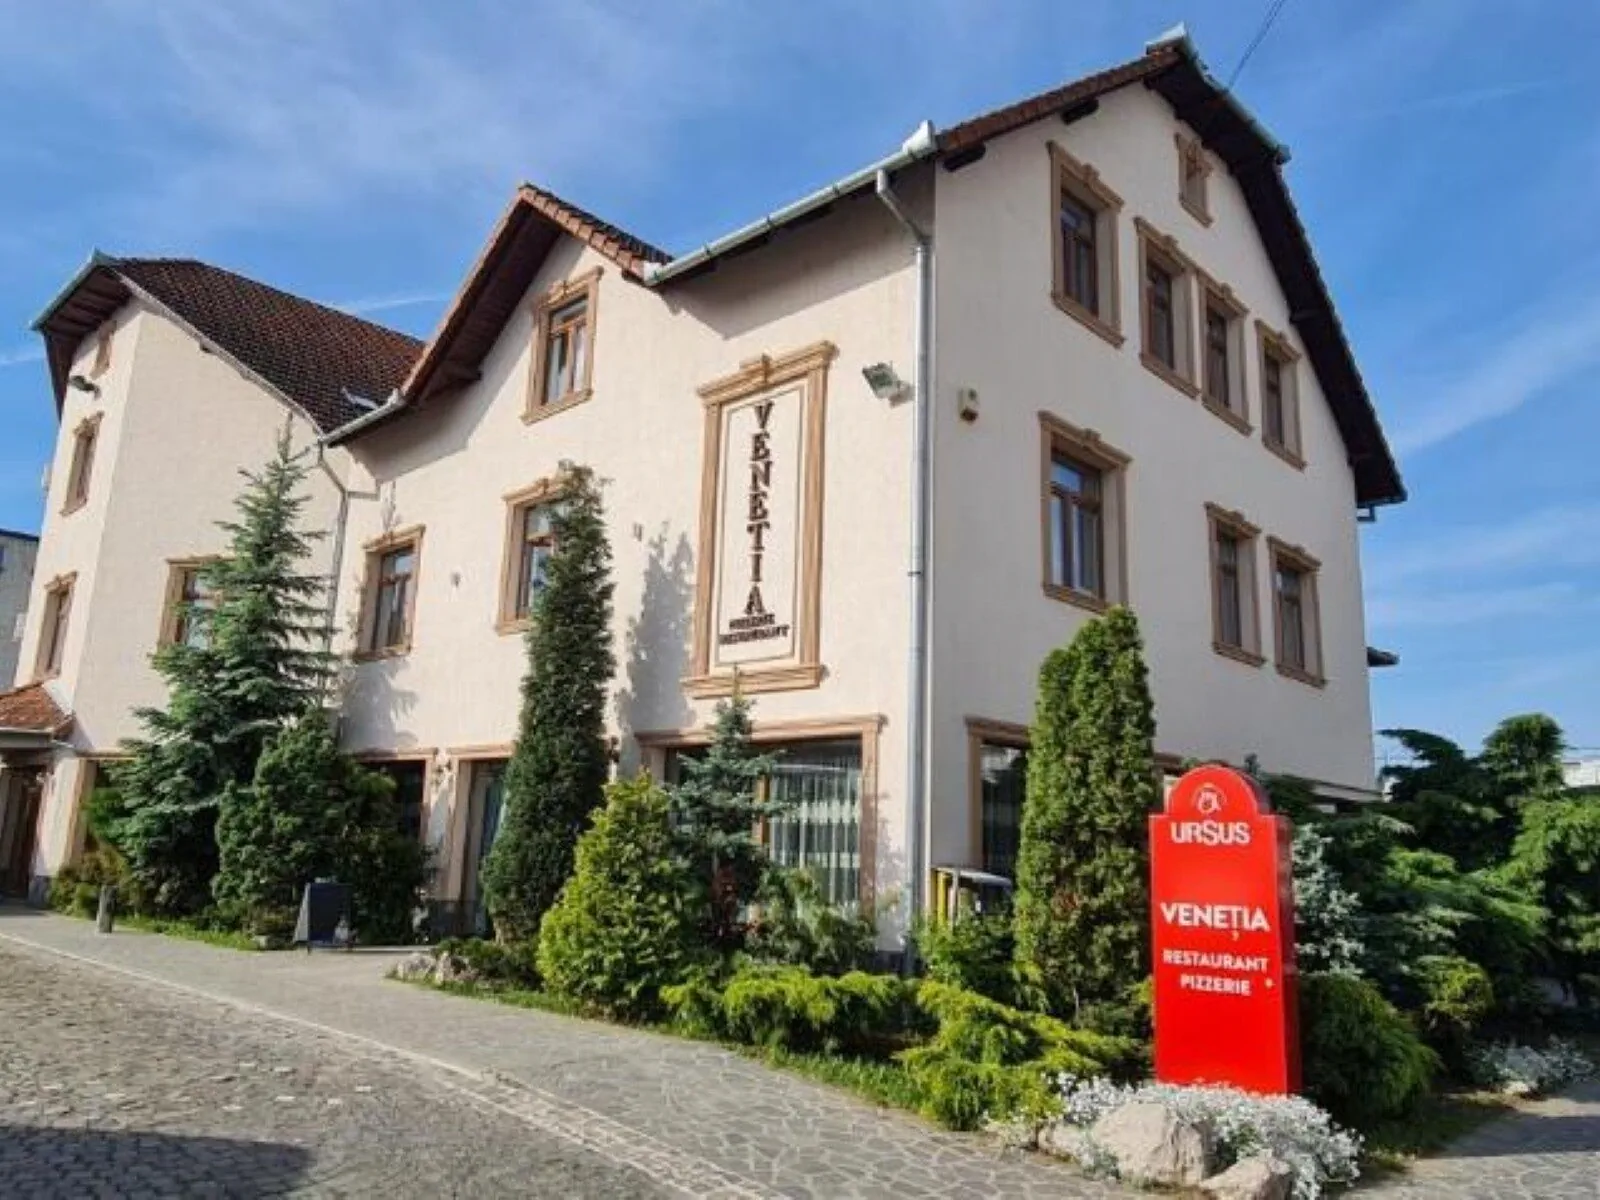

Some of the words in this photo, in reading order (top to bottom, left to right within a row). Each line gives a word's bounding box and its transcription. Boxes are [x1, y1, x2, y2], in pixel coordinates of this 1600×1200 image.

[745, 401, 774, 615] VENETIA
[1171, 820, 1251, 846] URSUS
[1162, 948, 1269, 972] RESTAURANT
[1180, 973, 1252, 996] PIZZERIE
